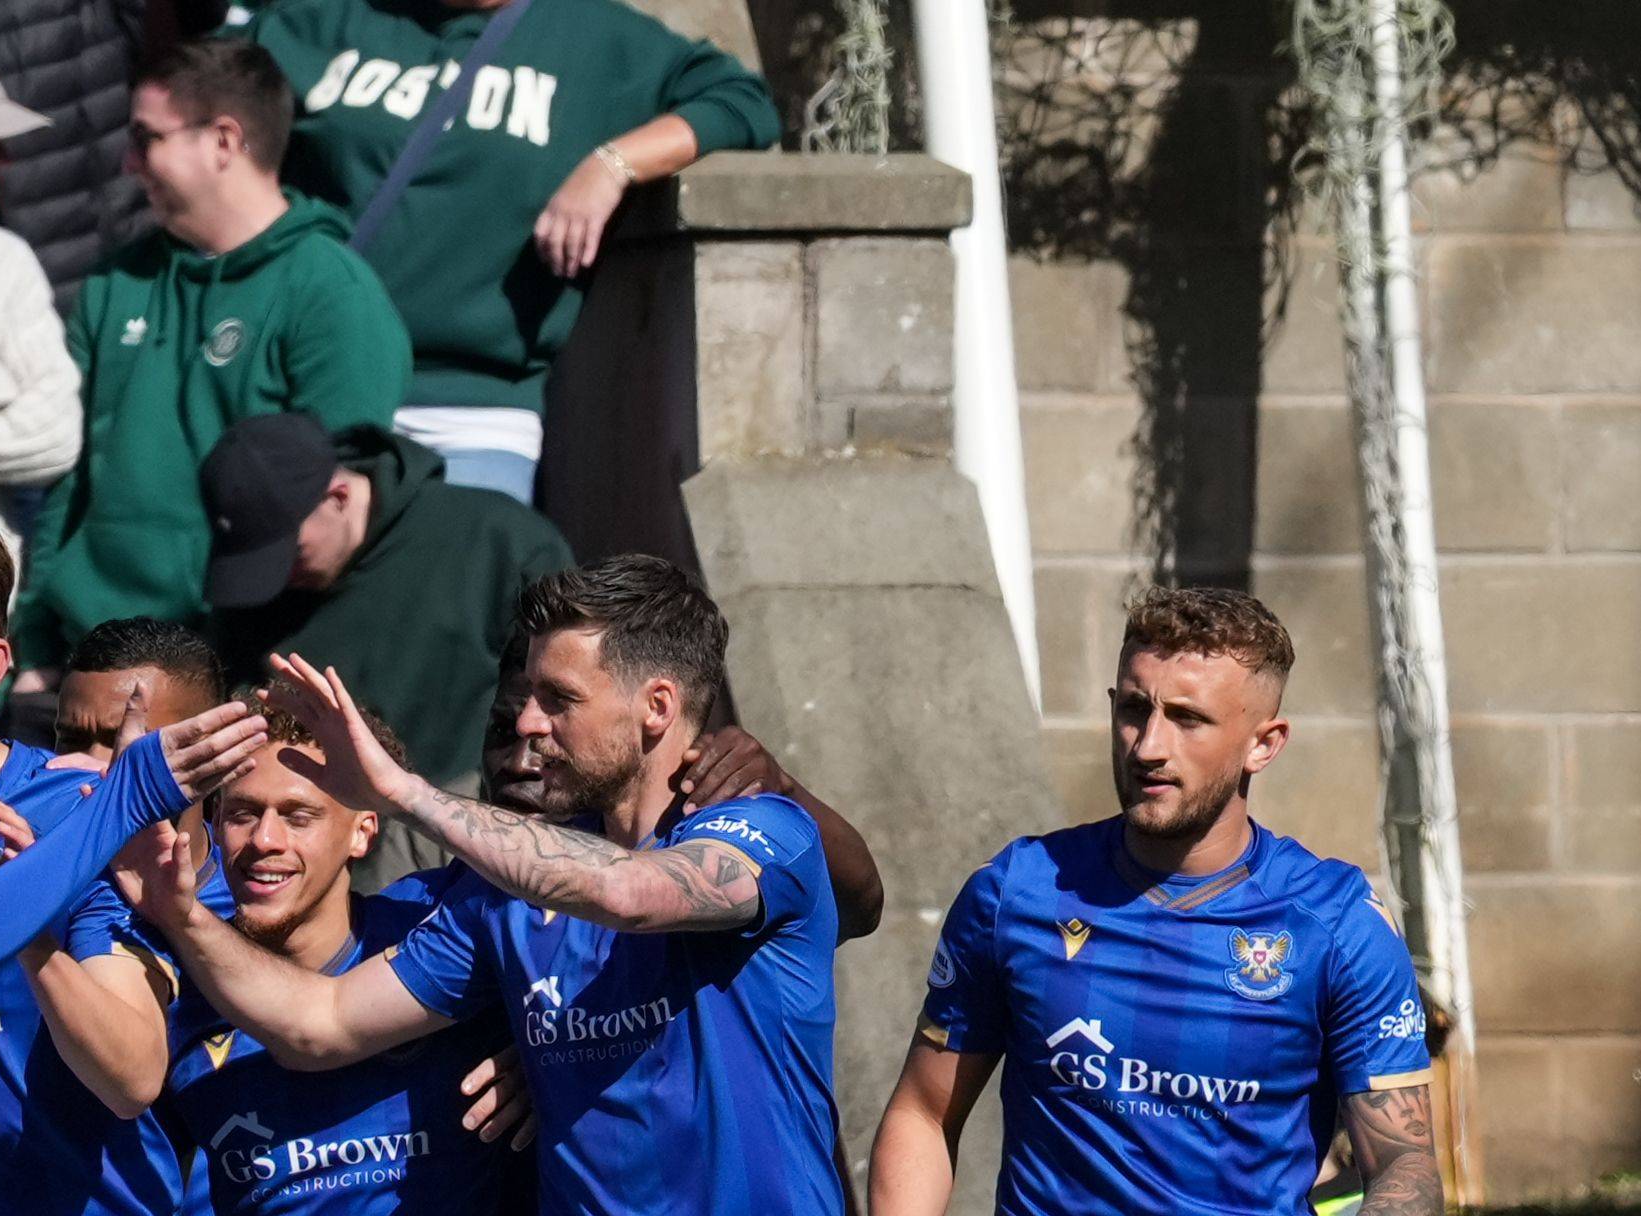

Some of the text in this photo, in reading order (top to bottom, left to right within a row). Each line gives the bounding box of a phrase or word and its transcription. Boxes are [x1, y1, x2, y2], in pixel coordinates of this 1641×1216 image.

[526, 997, 676, 1047] GS Brown
[1050, 1051, 1261, 1104] GS Brown
[221, 1130, 432, 1184] GS Brown
